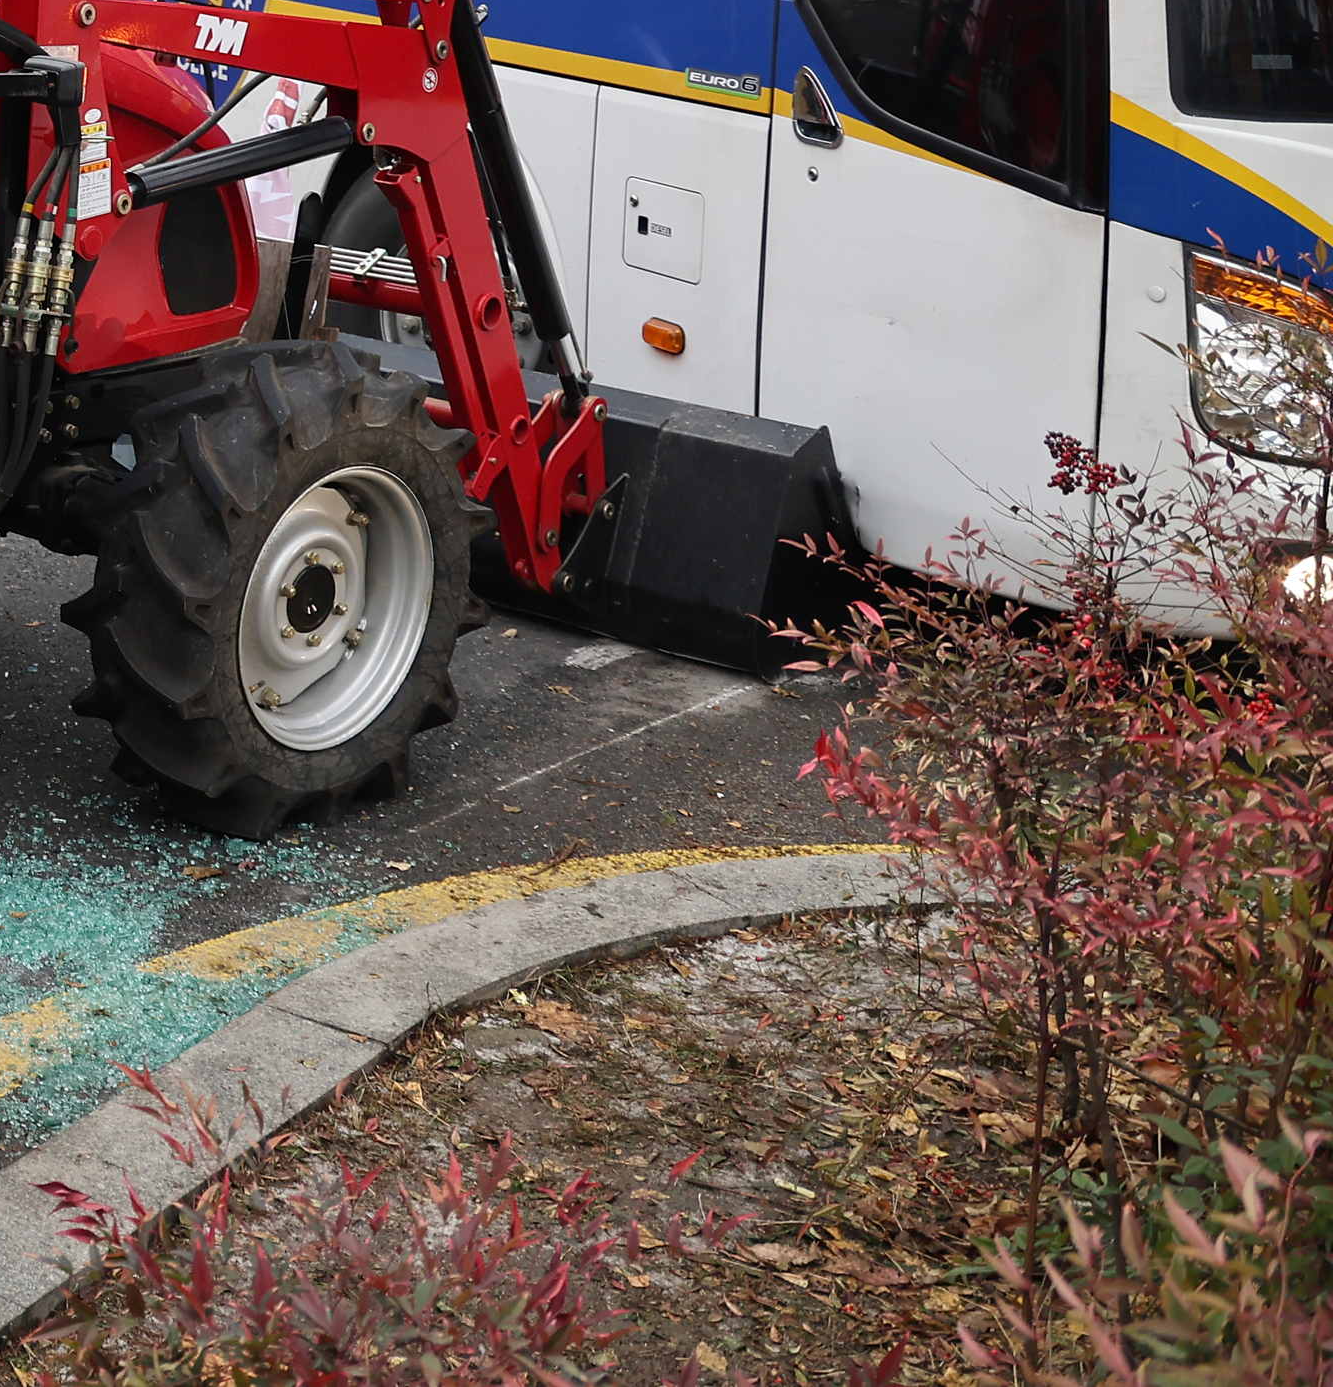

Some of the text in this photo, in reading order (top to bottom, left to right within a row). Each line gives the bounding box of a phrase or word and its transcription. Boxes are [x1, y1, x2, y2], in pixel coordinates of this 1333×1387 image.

[194, 13, 250, 57] TYM
[689, 72, 759, 94] EURO 6
